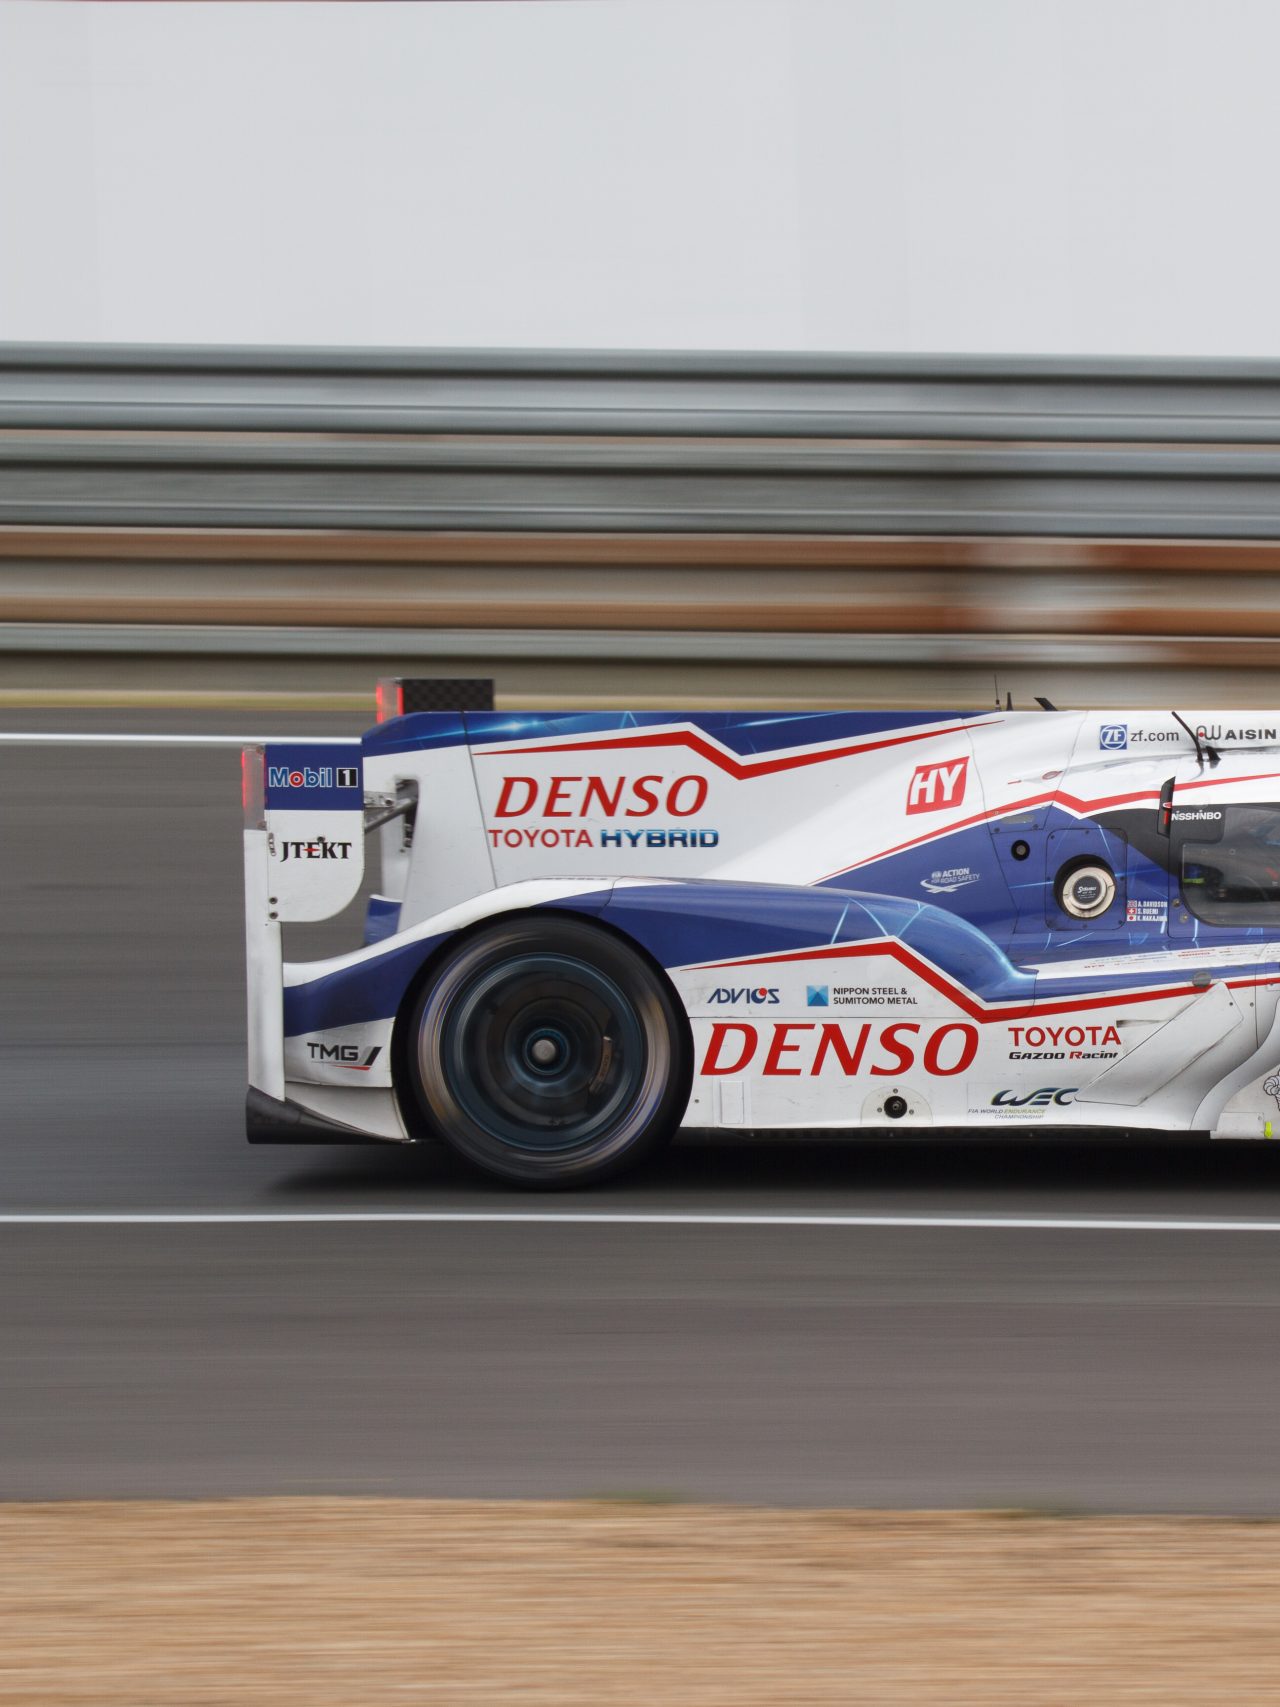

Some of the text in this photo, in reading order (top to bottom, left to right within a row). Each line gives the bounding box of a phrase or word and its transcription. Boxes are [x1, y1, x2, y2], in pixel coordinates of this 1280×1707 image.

[1130, 729, 1179, 742] zf.com
[1225, 729, 1276, 740] AISIN
[268, 766, 333, 788] Mobil
[909, 763, 965, 806] HY
[494, 775, 709, 817] DENSO
[487, 829, 719, 848] TOYOTA HYBRID
[280, 841, 352, 862] JTEKT
[942, 867, 970, 877] ACTION
[957, 873, 980, 882] SAFETY
[706, 987, 781, 1004] ADVICS
[833, 987, 908, 995] NIPPON STEEL &
[833, 997, 918, 1005] SUMITOMO METAL
[1008, 1026, 1122, 1047] TOYOTA
[307, 1042, 359, 1062] TMG
[700, 1022, 979, 1076] DENSO
[1008, 1051, 1065, 1060] GAZOO
[991, 1086, 1080, 1107] WEC
